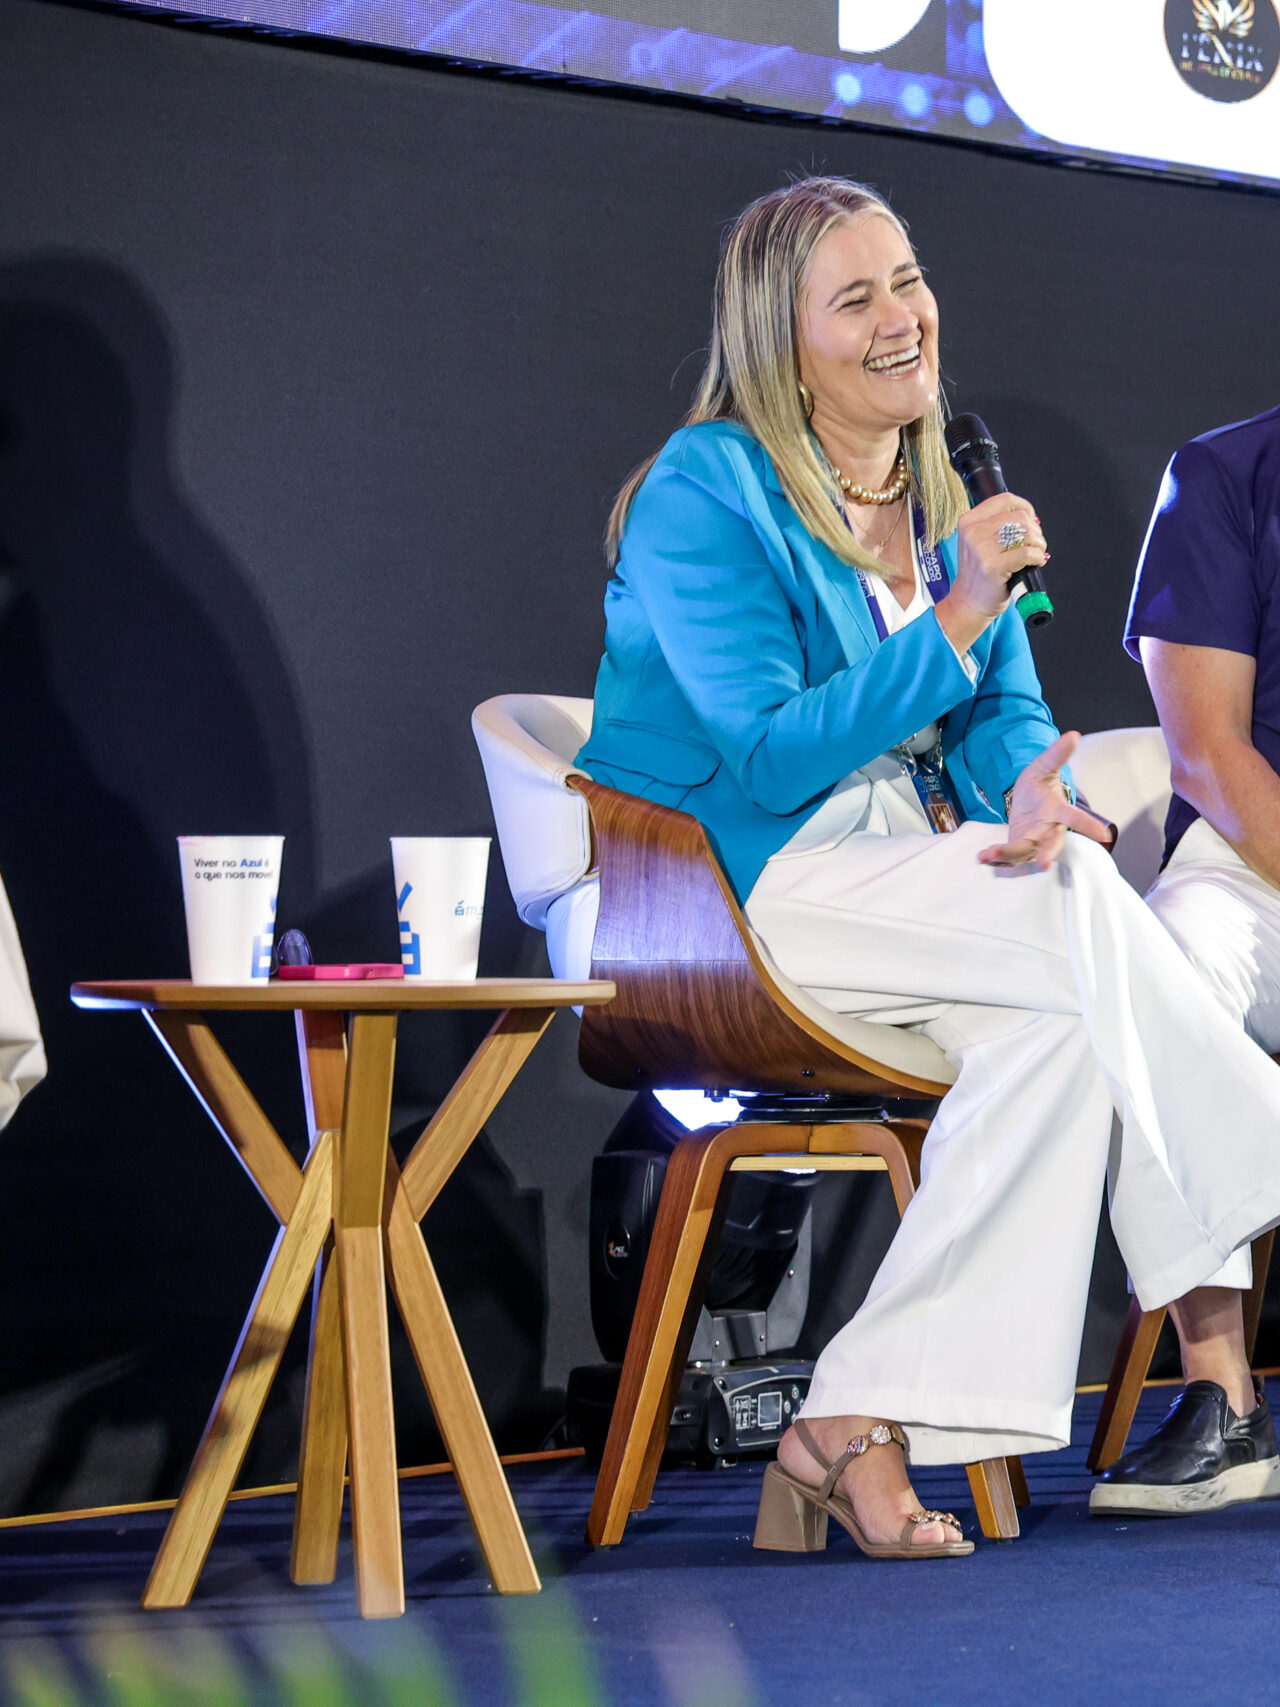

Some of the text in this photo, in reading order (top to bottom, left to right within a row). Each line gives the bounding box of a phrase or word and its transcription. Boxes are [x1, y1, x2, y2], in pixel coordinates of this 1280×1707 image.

[194, 858, 219, 867] Viver
[240, 858, 263, 867] Azul
[203, 872, 221, 881] que
[225, 871, 246, 879] nos
